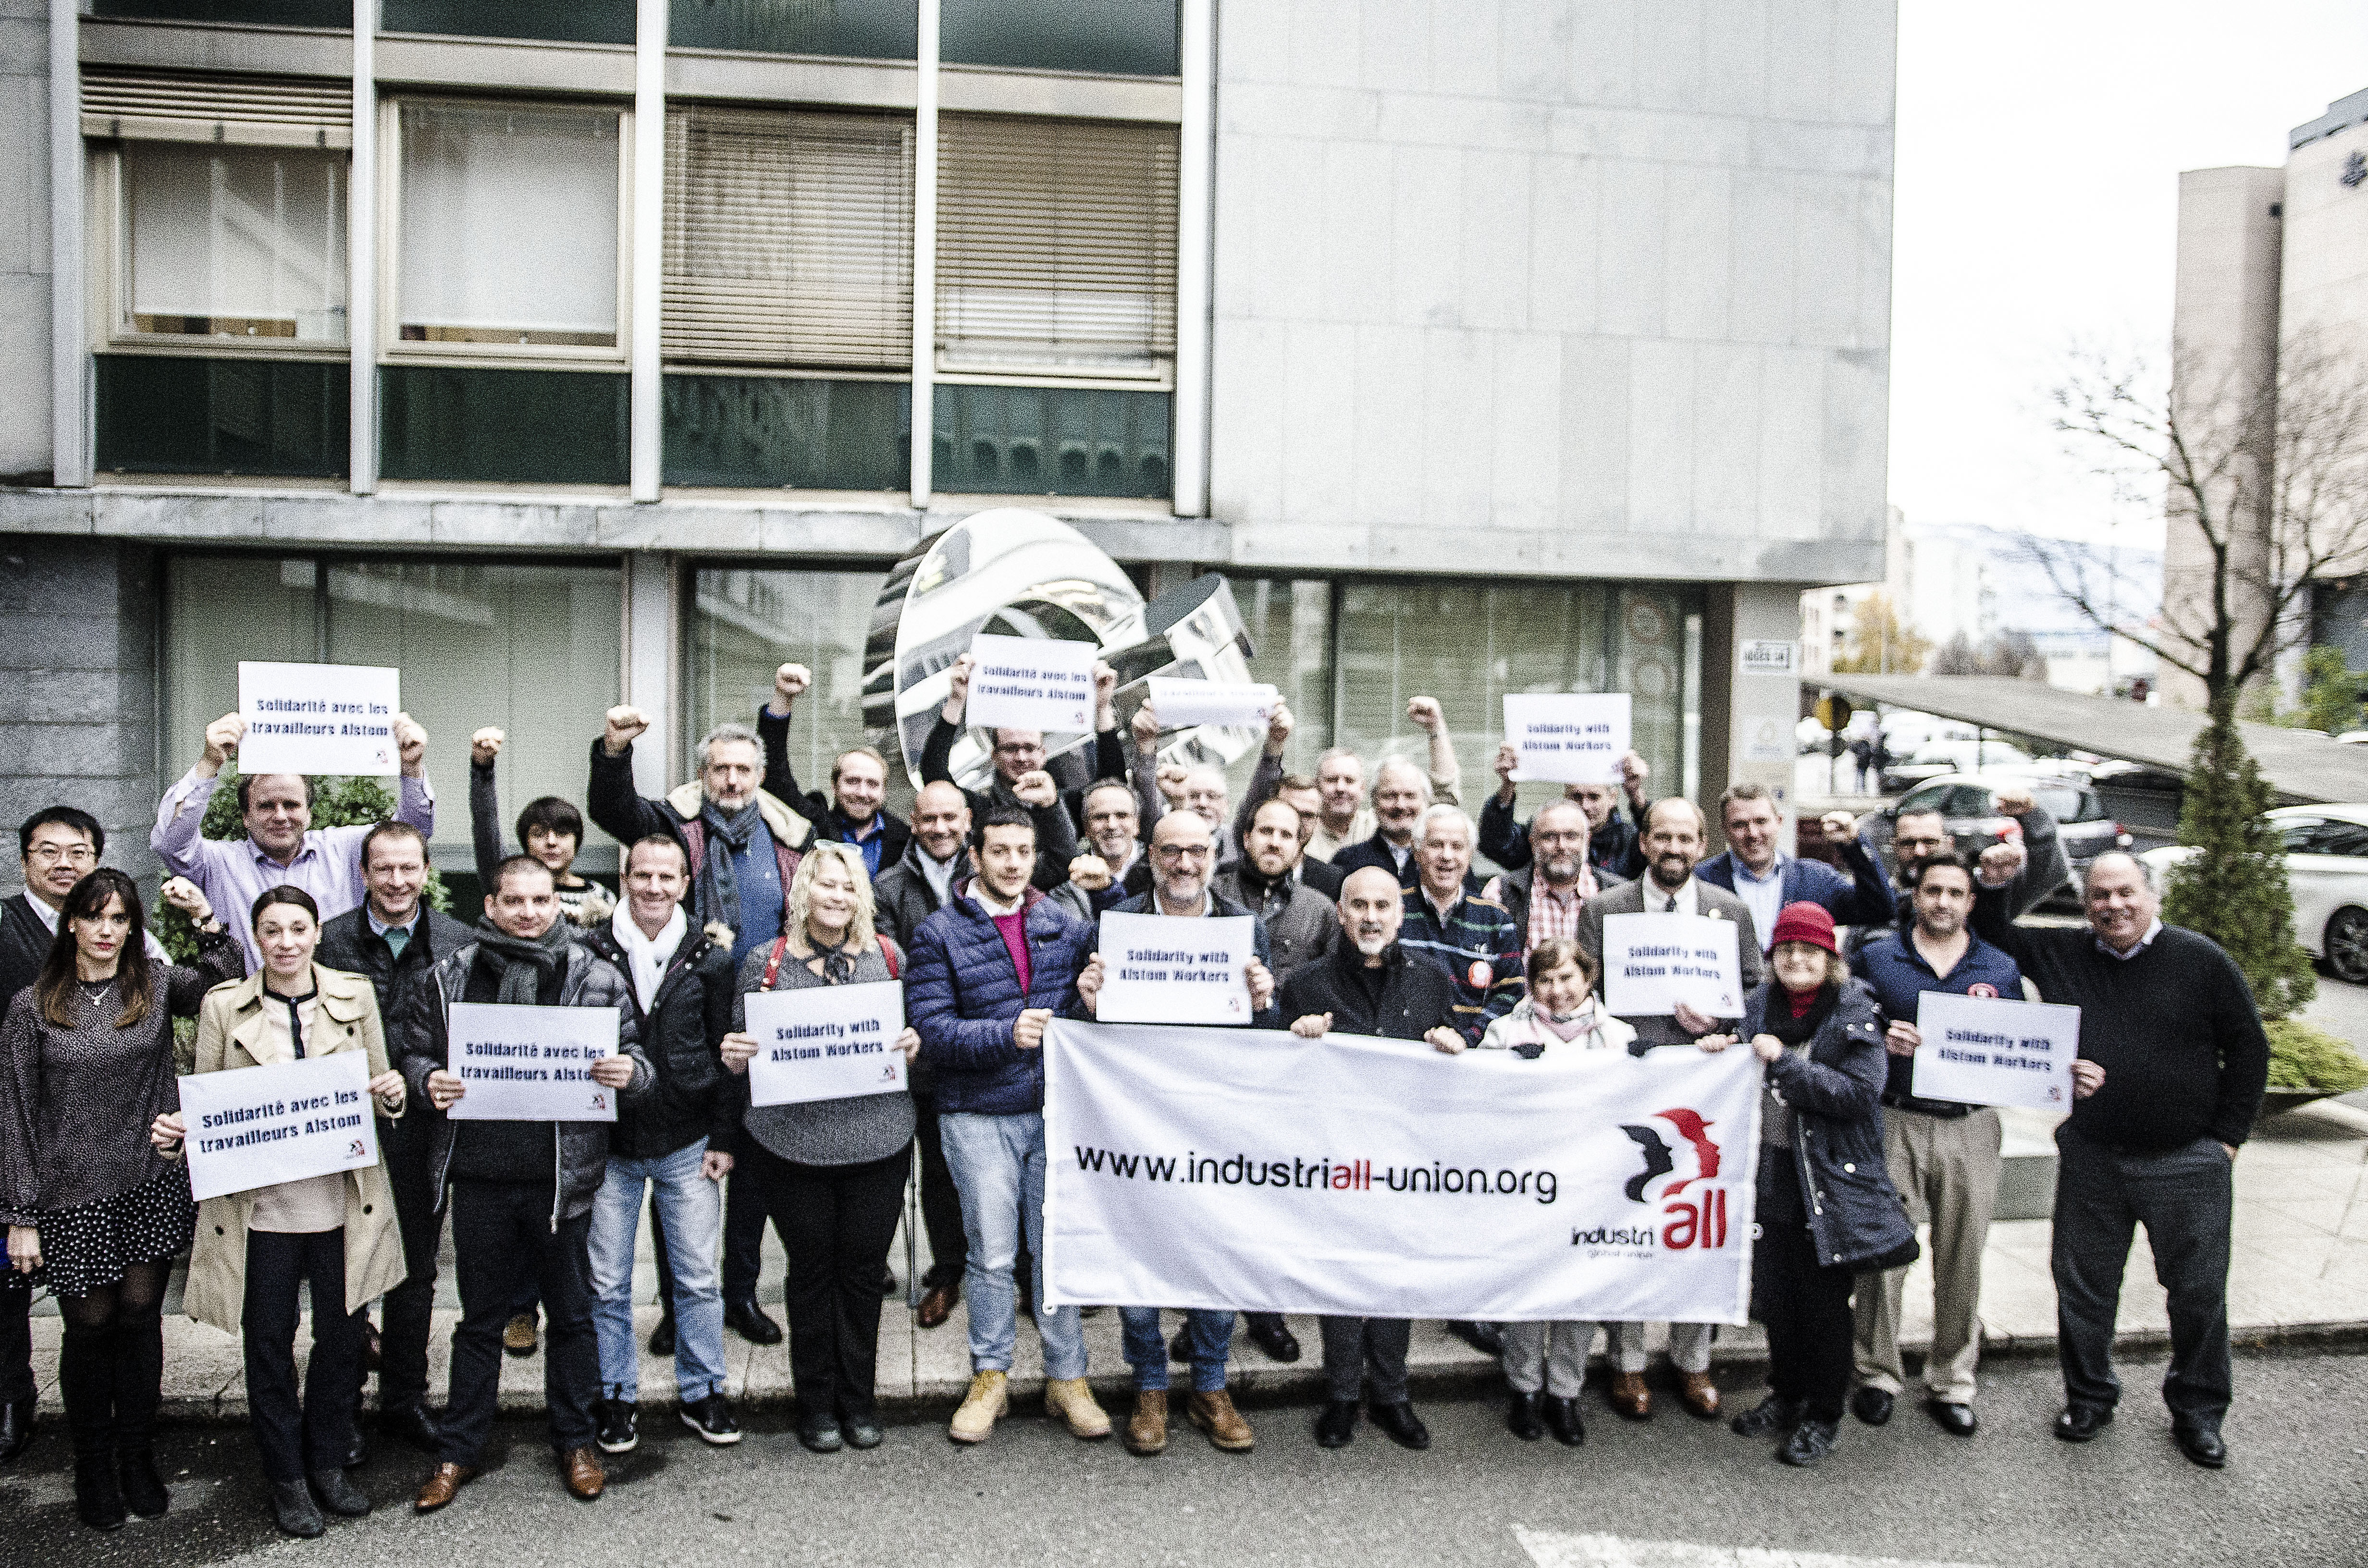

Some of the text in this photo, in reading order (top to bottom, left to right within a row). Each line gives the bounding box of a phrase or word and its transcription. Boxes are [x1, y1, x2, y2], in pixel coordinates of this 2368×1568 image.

[257, 699, 388, 715] Solidarité avec les
[252, 722, 388, 736] travailleurs Alstom
[1127, 949, 1229, 965] Solidarity with
[1120, 968, 1229, 982] Alstom Workers
[776, 1019, 880, 1041] Solidarity with
[466, 1042, 605, 1058] Solidarité avec les
[771, 1041, 883, 1062] Alstom Workers
[461, 1066, 593, 1081] travailleurs Alsto
[201, 1091, 358, 1129] Solidarité avec les
[199, 1114, 361, 1153] travailleurs Alstom
[1074, 1145, 1557, 1205] www.industriall-union.org
